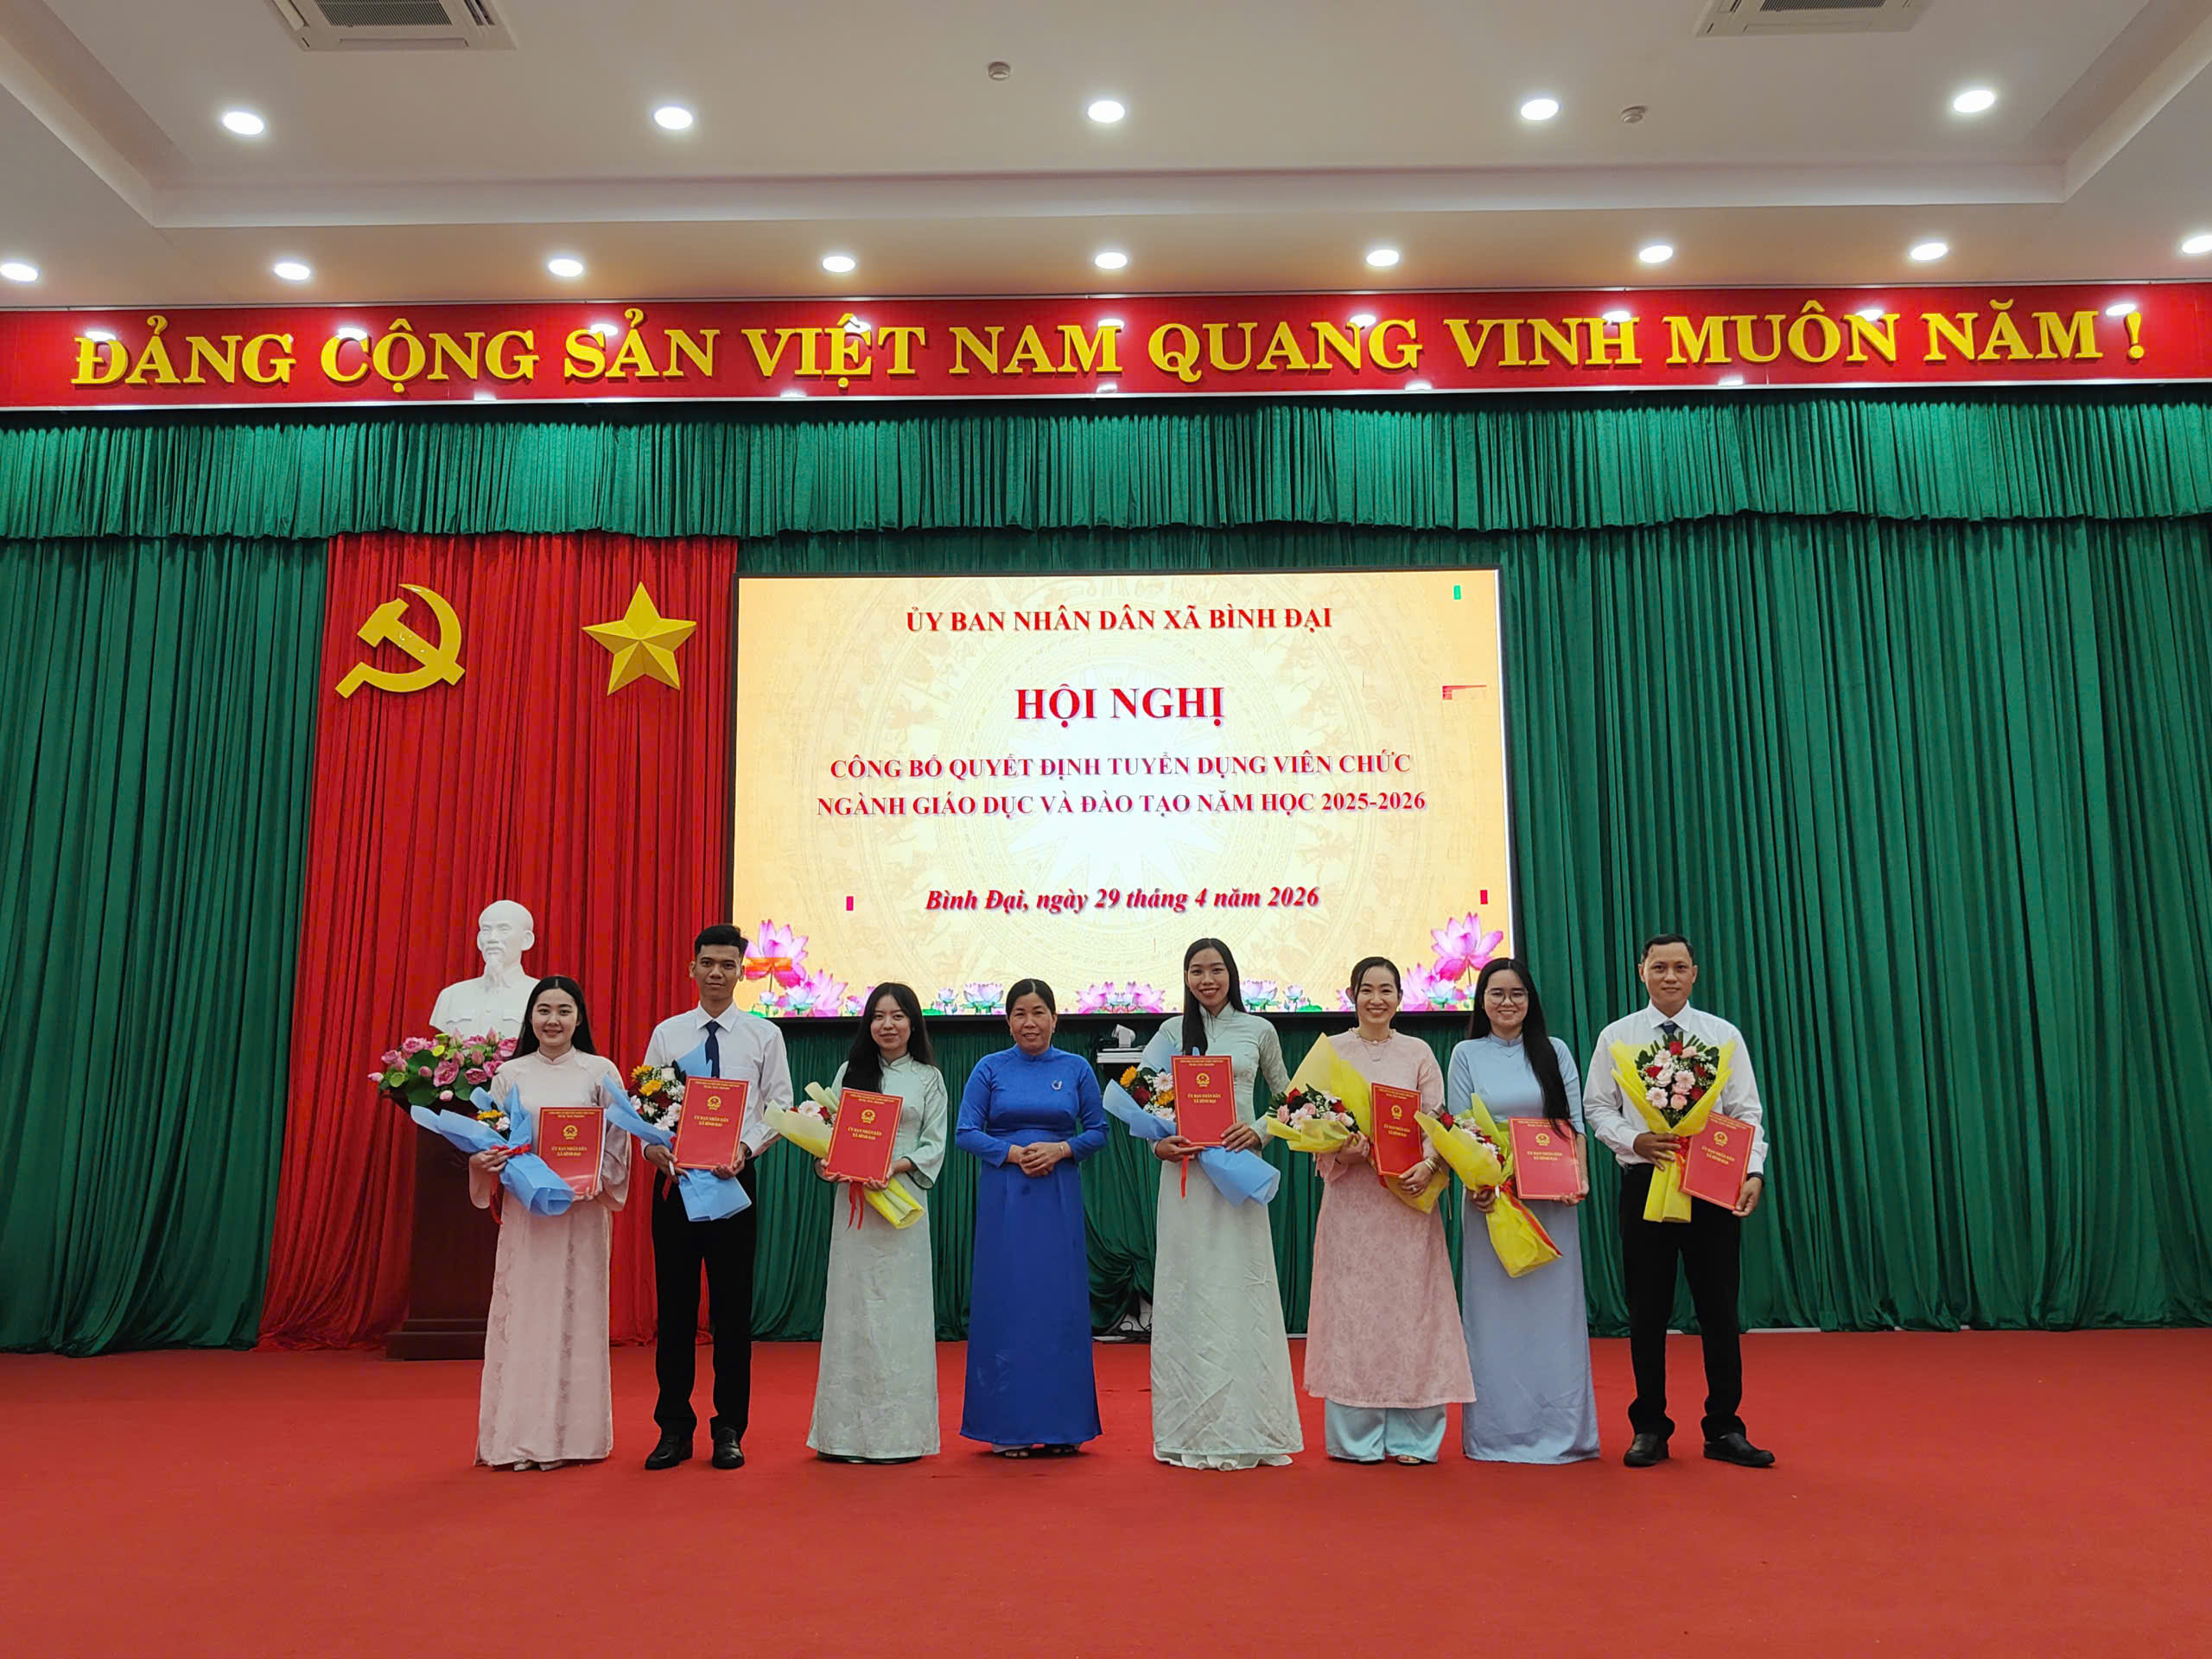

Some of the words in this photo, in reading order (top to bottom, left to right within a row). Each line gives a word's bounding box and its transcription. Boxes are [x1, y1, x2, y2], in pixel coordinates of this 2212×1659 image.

[71, 315, 296, 385] ĐẢNG
[321, 317, 539, 393] CỘNG
[563, 307, 721, 378] SẢN
[741, 312, 925, 388] VIỆT
[949, 324, 1122, 374] NAM
[1148, 321, 1423, 383] QUANG
[1443, 318, 1643, 367] VINH
[1663, 300, 1900, 364] MUÔN
[1921, 299, 2103, 361] NĂM
[2126, 311, 2145, 359] !
[906, 606, 944, 632] ỦY
[950, 612, 1005, 632] BAN
[1014, 604, 1090, 631] NHÂN
[1099, 603, 1154, 630] DÂN
[1164, 604, 1202, 629] XÃ
[1210, 603, 1276, 629] BÌNH
[1285, 607, 1332, 633] ĐẠI
[1014, 683, 1098, 728] HỘI
[1109, 687, 1225, 727] NGHỊ
[830, 754, 901, 779] CÔNG
[908, 754, 943, 778] BỐ
[949, 753, 1033, 781] QUYẾT
[1039, 758, 1101, 780] ĐỊNH
[1107, 752, 1190, 776] TUYỂN
[1197, 756, 1267, 779] DỤNG
[1273, 750, 1332, 774] VIÊN
[1338, 749, 1411, 773] CHỨC
[817, 792, 906, 816] NGÀNH
[912, 791, 976, 815] GIÁO
[983, 796, 1033, 818] DỤC
[1039, 791, 1074, 814] VÀ
[1080, 791, 1133, 813] ĐÀO
[1139, 794, 1191, 817] TẠO
[1198, 790, 1253, 812] NĂM
[1262, 793, 1314, 817] HỌC
[1321, 791, 1426, 810] 2025-2026
[926, 889, 978, 910] Bình
[985, 889, 1028, 914] Đại,
[1036, 888, 1088, 914] ngày
[1095, 888, 1121, 908] 29
[1126, 888, 1188, 913] tháng
[1195, 887, 1208, 907] 4
[1213, 887, 1261, 907] năm
[1267, 886, 1320, 906] 2026
